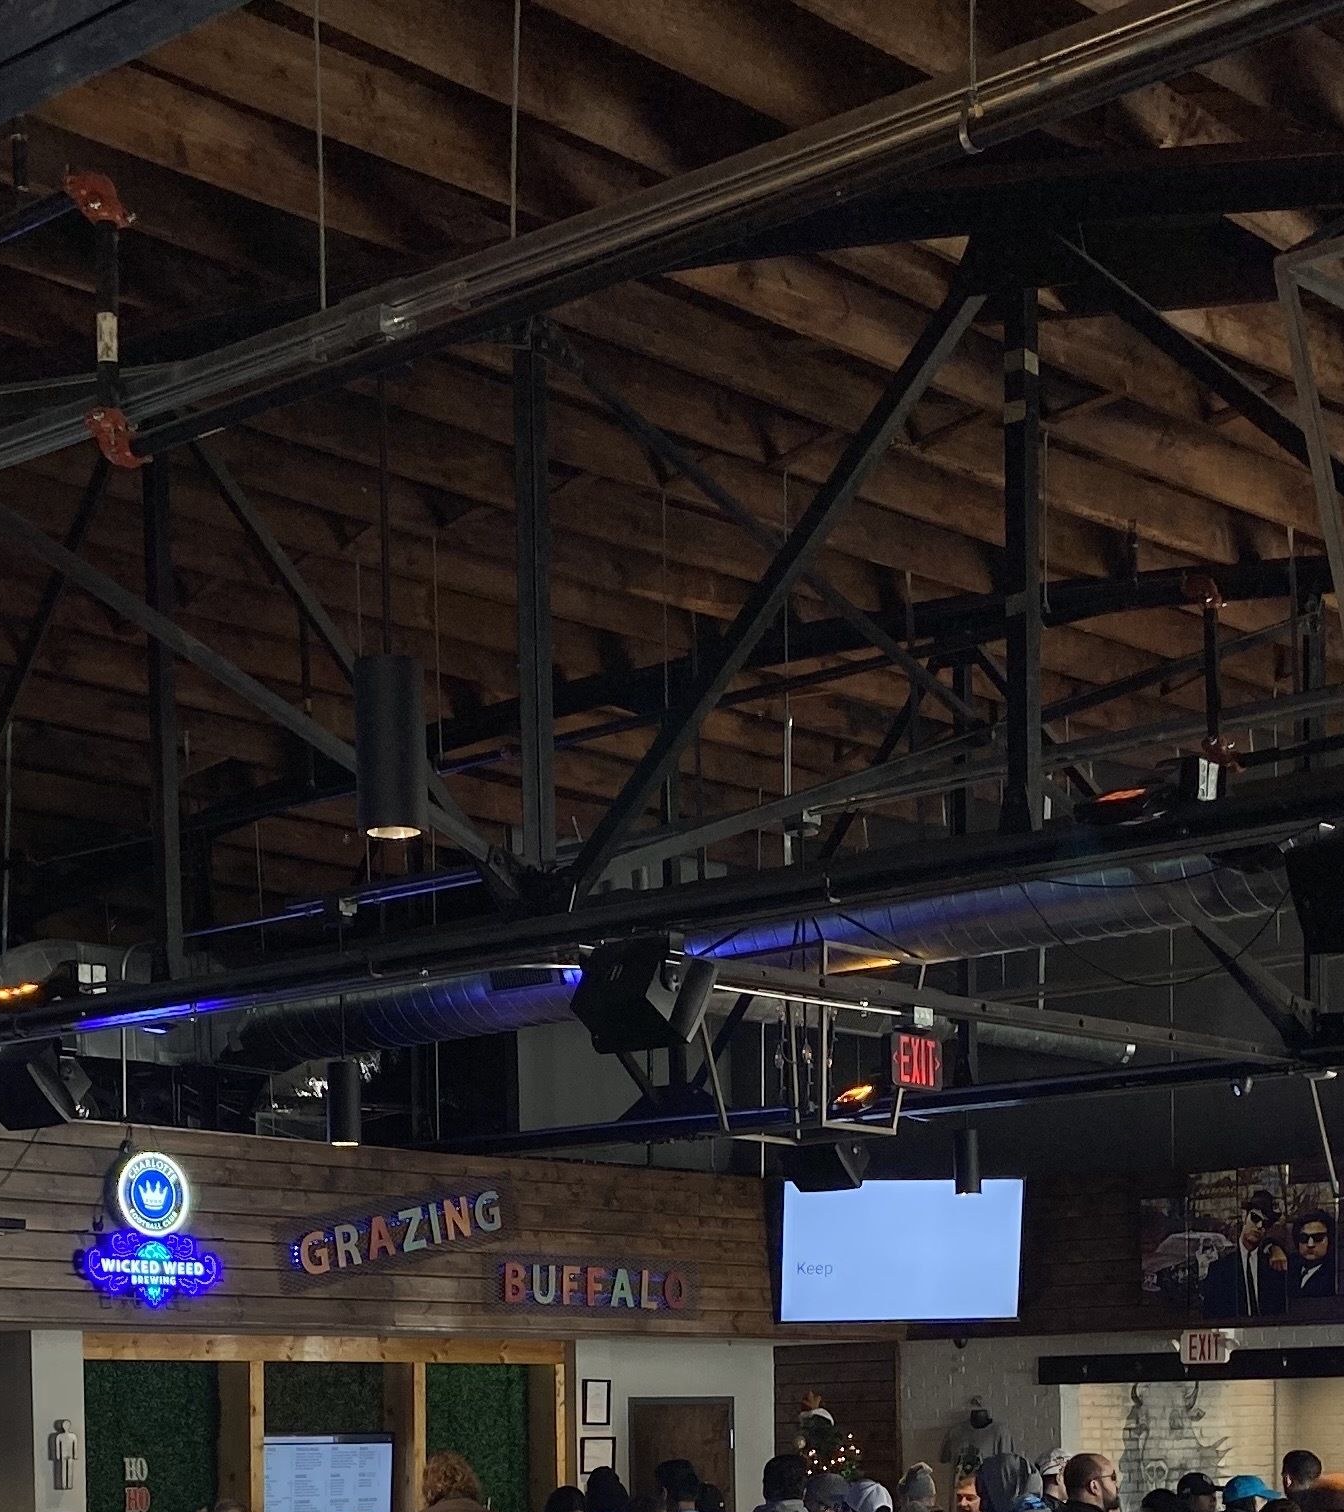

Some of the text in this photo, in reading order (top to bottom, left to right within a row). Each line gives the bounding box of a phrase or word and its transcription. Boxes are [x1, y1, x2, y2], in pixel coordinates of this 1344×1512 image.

[899, 1034, 936, 1087] EXIT
[128, 1158, 178, 1182] CHARLOTTE
[129, 1208, 162, 1230] FOOTBALL
[300, 1190, 503, 1275] GRAZING
[100, 1258, 205, 1276] WICKED WEED
[796, 1261, 833, 1278] Keep
[131, 1275, 177, 1286] BREWING
[504, 1262, 689, 1311] BUFFALO
[1188, 1333, 1221, 1361] EXIT
[123, 1457, 149, 1481] HO
[125, 1486, 151, 1512] HO
